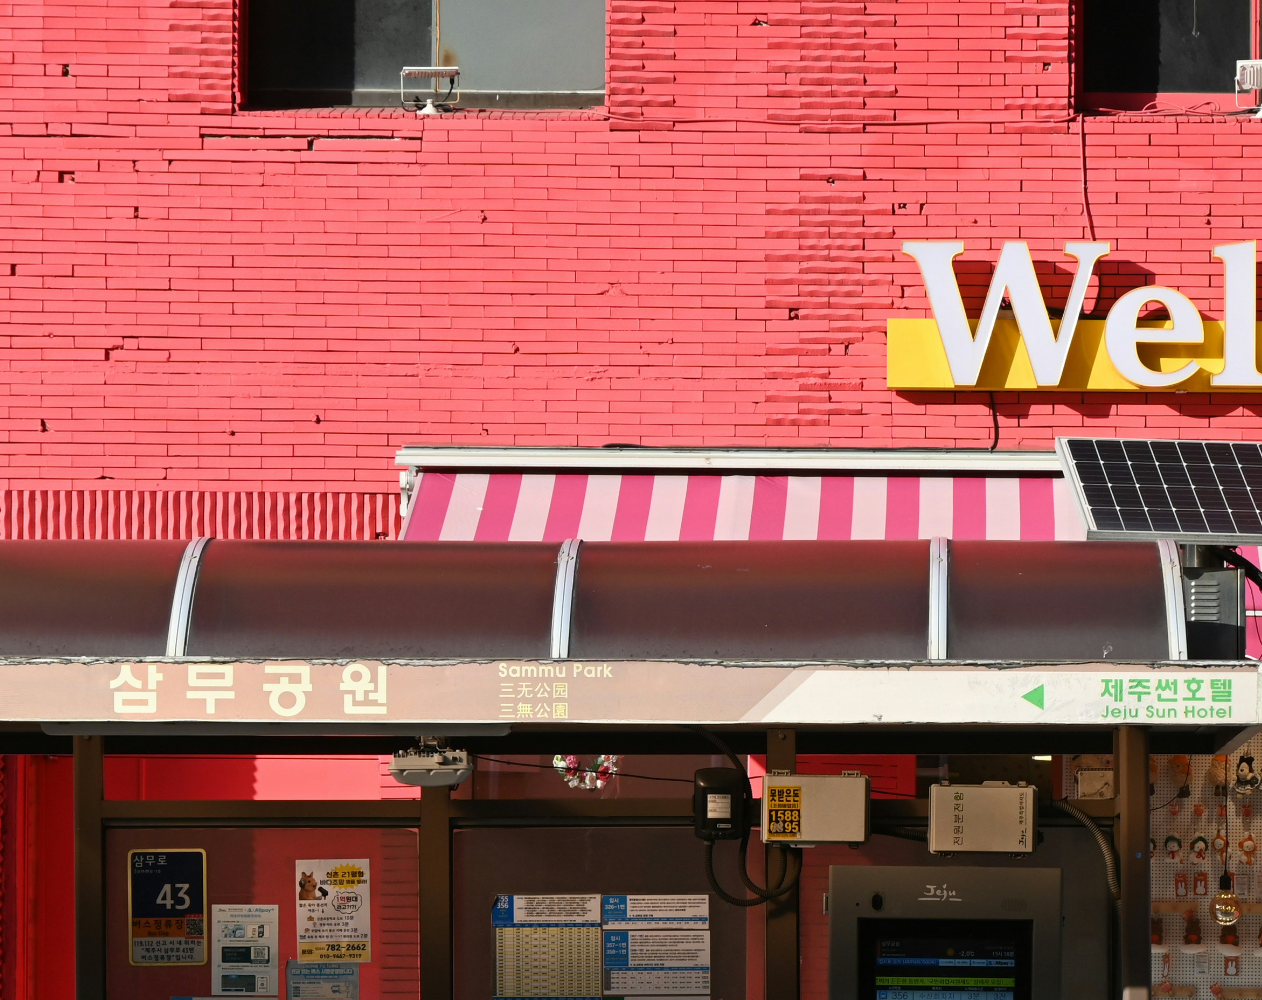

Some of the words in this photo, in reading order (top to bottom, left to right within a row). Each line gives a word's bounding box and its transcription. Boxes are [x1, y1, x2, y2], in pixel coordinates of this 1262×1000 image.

[498, 662, 566, 678] Sammu
[573, 663, 613, 678] Park
[109, 663, 388, 717] 삼무공원
[498, 682, 568, 699] 三无公园
[1100, 677, 1233, 703] 제주썬호텔
[498, 702, 568, 719] 三無公園
[1101, 704, 1139, 720] Jeju
[1145, 704, 1178, 719] Sun
[1184, 705, 1232, 719] Hotel
[770, 788, 800, 803] 못받은돈
[770, 810, 800, 822] 1588
[953, 791, 964, 846] 전원분전함
[770, 821, 800, 833] 95
[133, 854, 168, 868] 삼무로
[156, 883, 191, 910] 43
[922, 883, 957, 902] Jeju
[132, 919, 184, 930] 버스정류장
